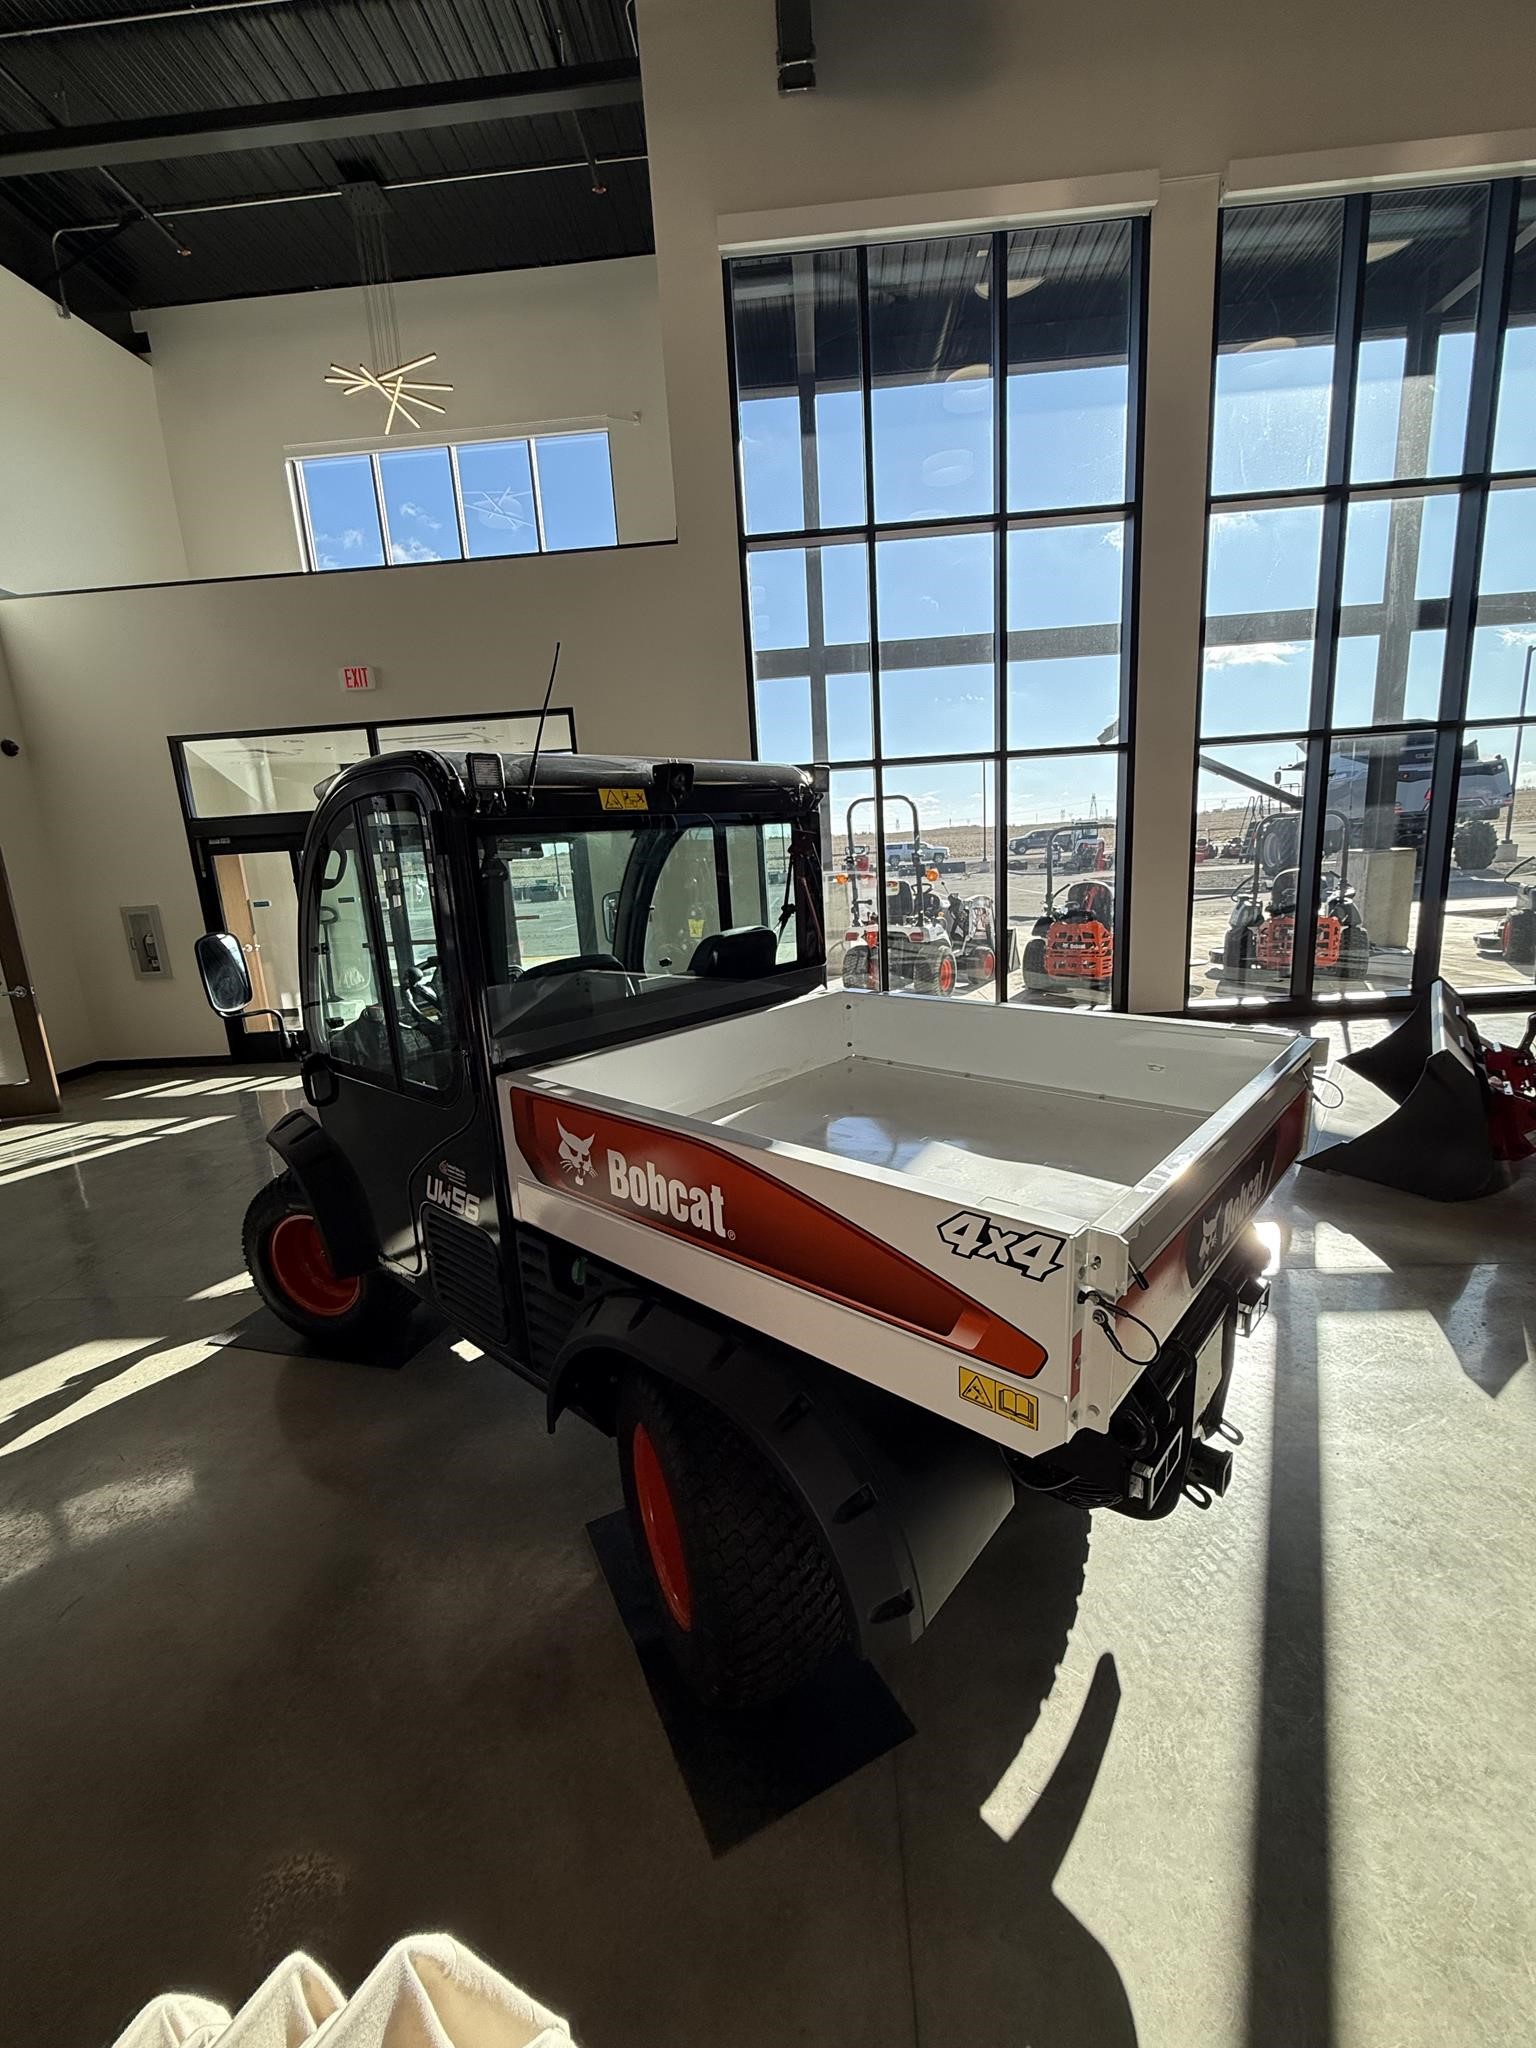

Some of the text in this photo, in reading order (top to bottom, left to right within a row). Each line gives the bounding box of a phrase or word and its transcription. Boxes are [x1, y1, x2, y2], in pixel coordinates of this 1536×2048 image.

[344, 667, 368, 689] EXIT
[426, 1174, 481, 1222] UW56
[607, 1148, 727, 1238] Bobcat
[1221, 1160, 1265, 1246] Bobcat
[937, 1210, 1067, 1282] 4x4
